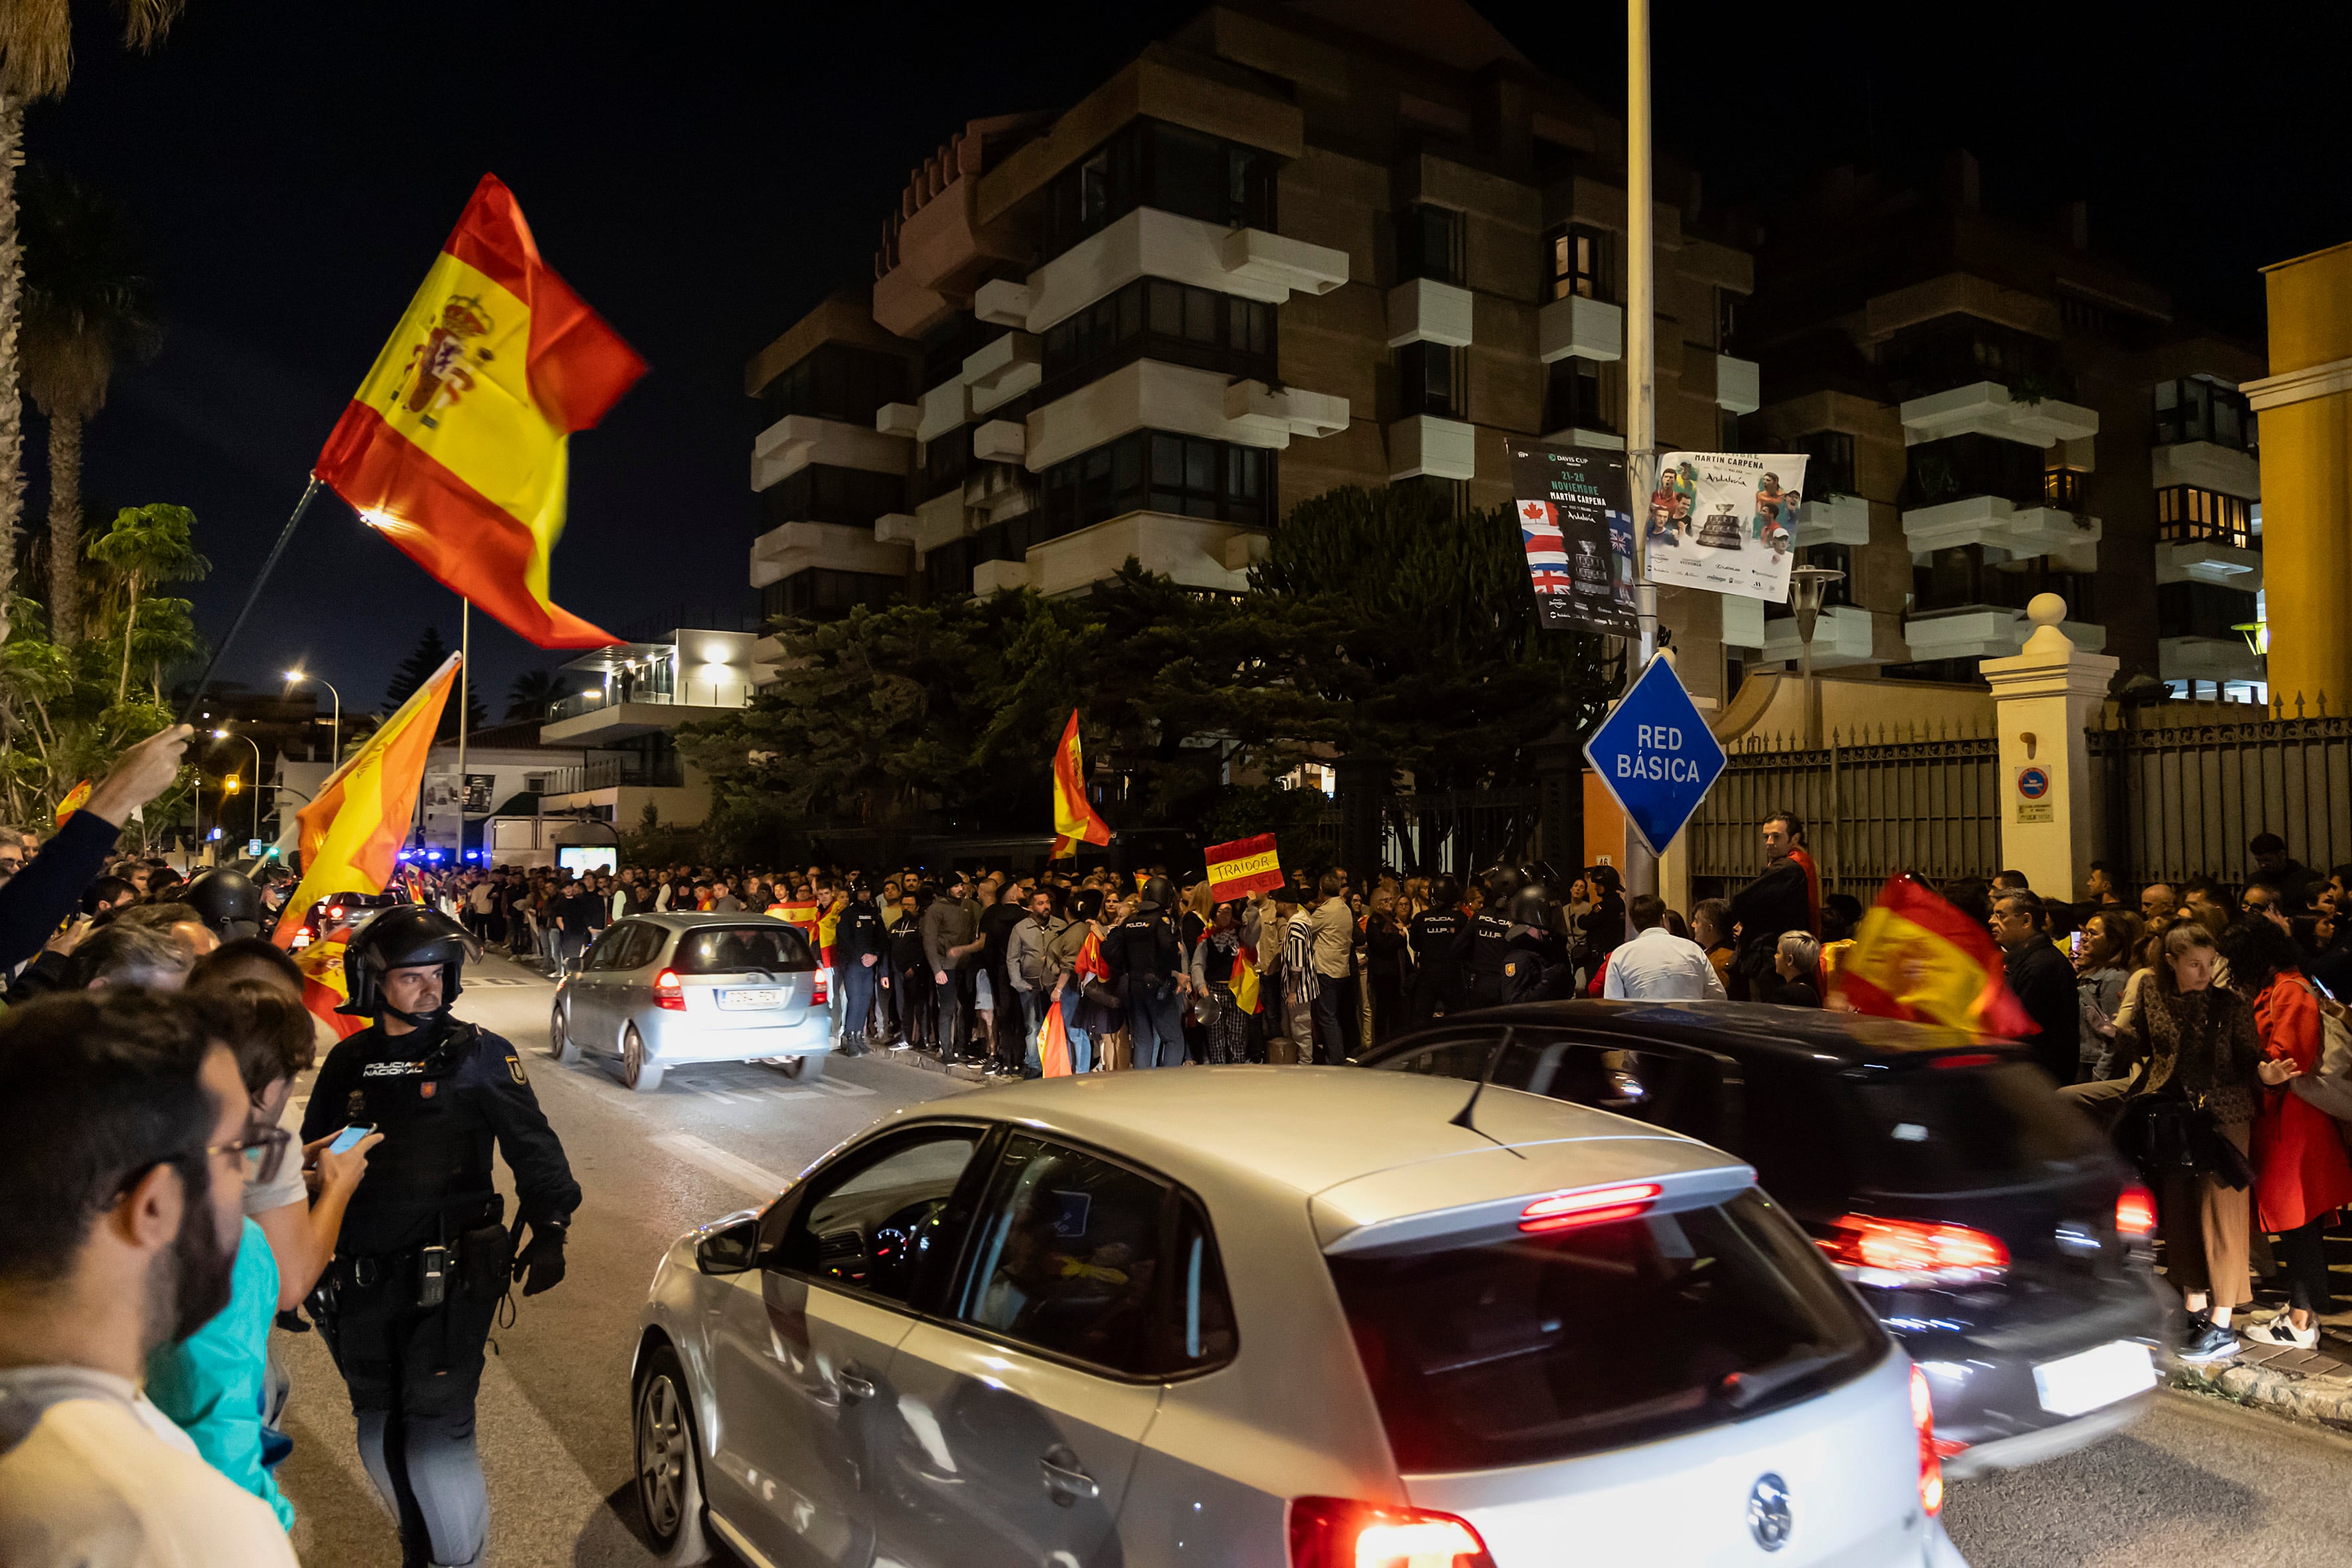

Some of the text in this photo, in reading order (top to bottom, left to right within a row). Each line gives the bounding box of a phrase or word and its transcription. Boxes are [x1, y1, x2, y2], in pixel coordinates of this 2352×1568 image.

[1727, 457, 1763, 469] CARPENA
[1551, 481, 1599, 496] NOVIEMBRE
[1549, 491, 1607, 507] MARTÍN CARPENA
[1638, 724, 1682, 750] RED
[1617, 750, 1700, 783] BÁSICA
[364, 1061, 412, 1070] POLICIA
